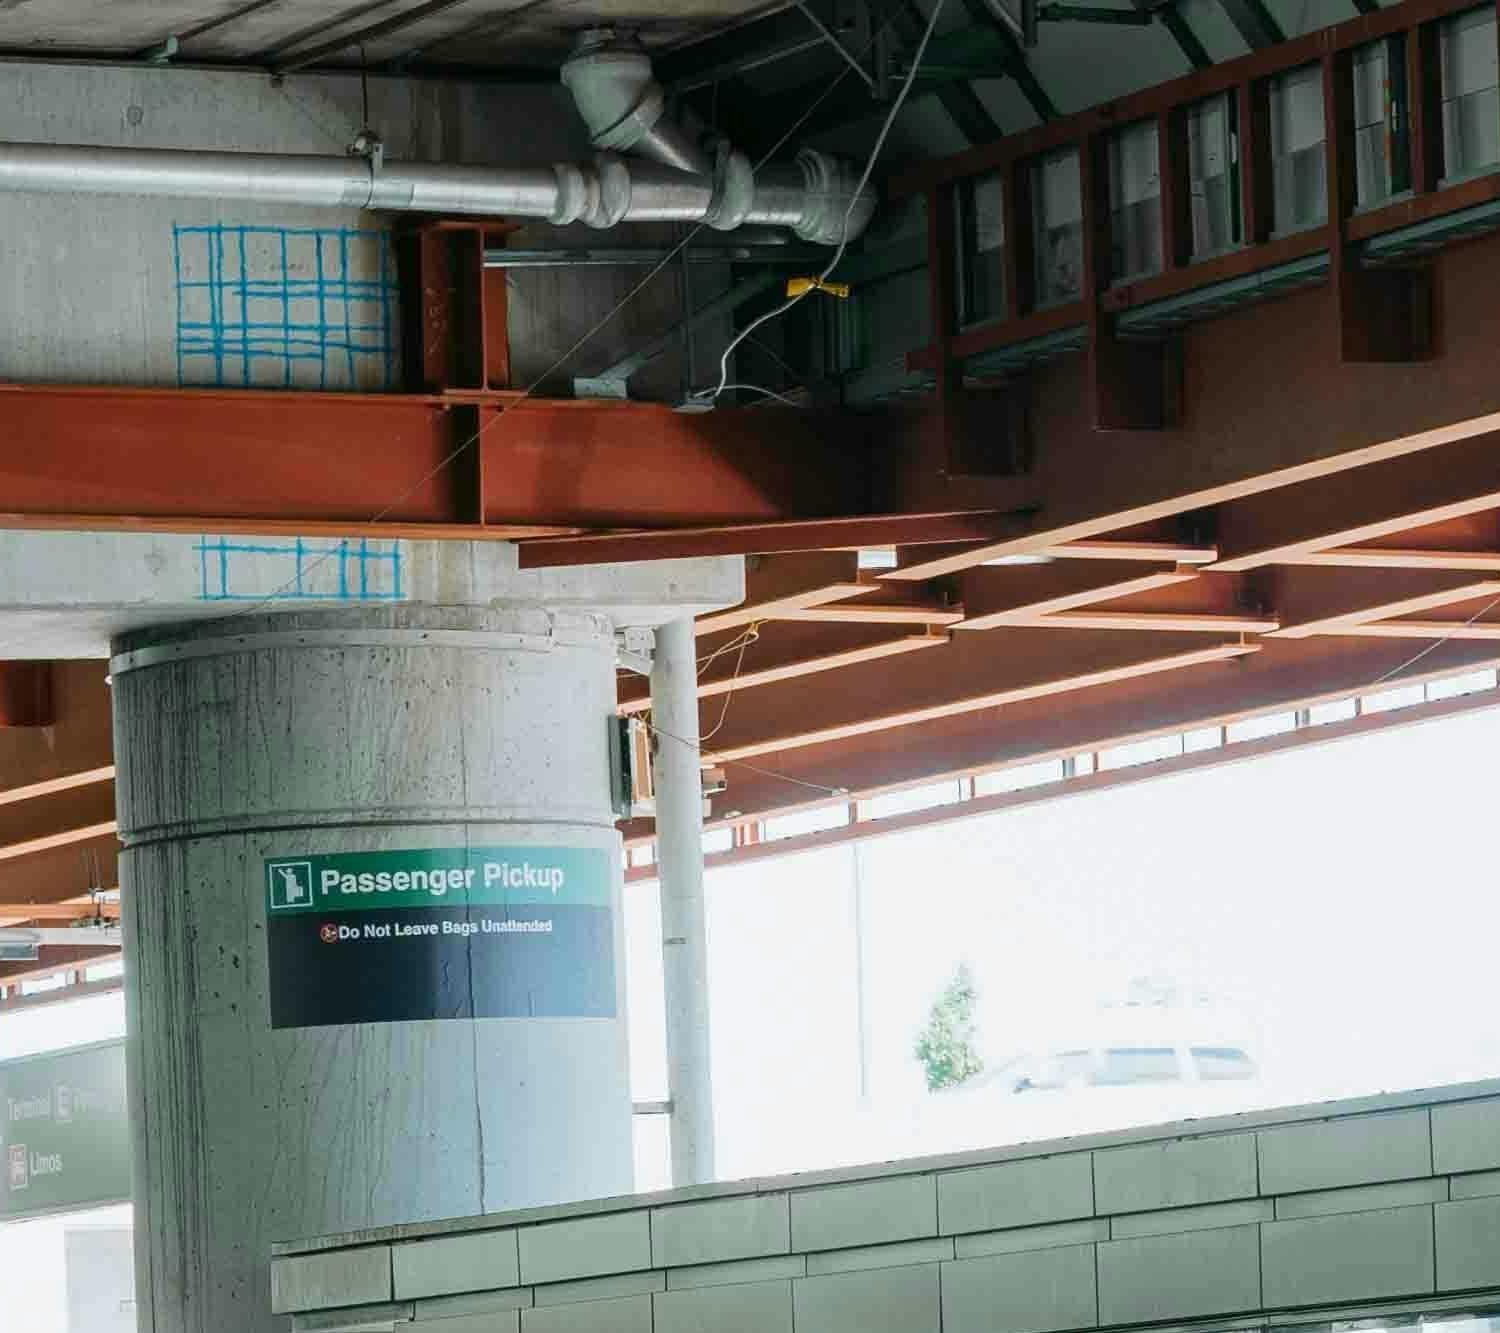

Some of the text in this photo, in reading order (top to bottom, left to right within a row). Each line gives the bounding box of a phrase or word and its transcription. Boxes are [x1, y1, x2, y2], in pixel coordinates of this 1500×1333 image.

[320, 863, 565, 895] Passenger Pickup
[338, 918, 552, 939] Do Not Leave Bags Unattended
